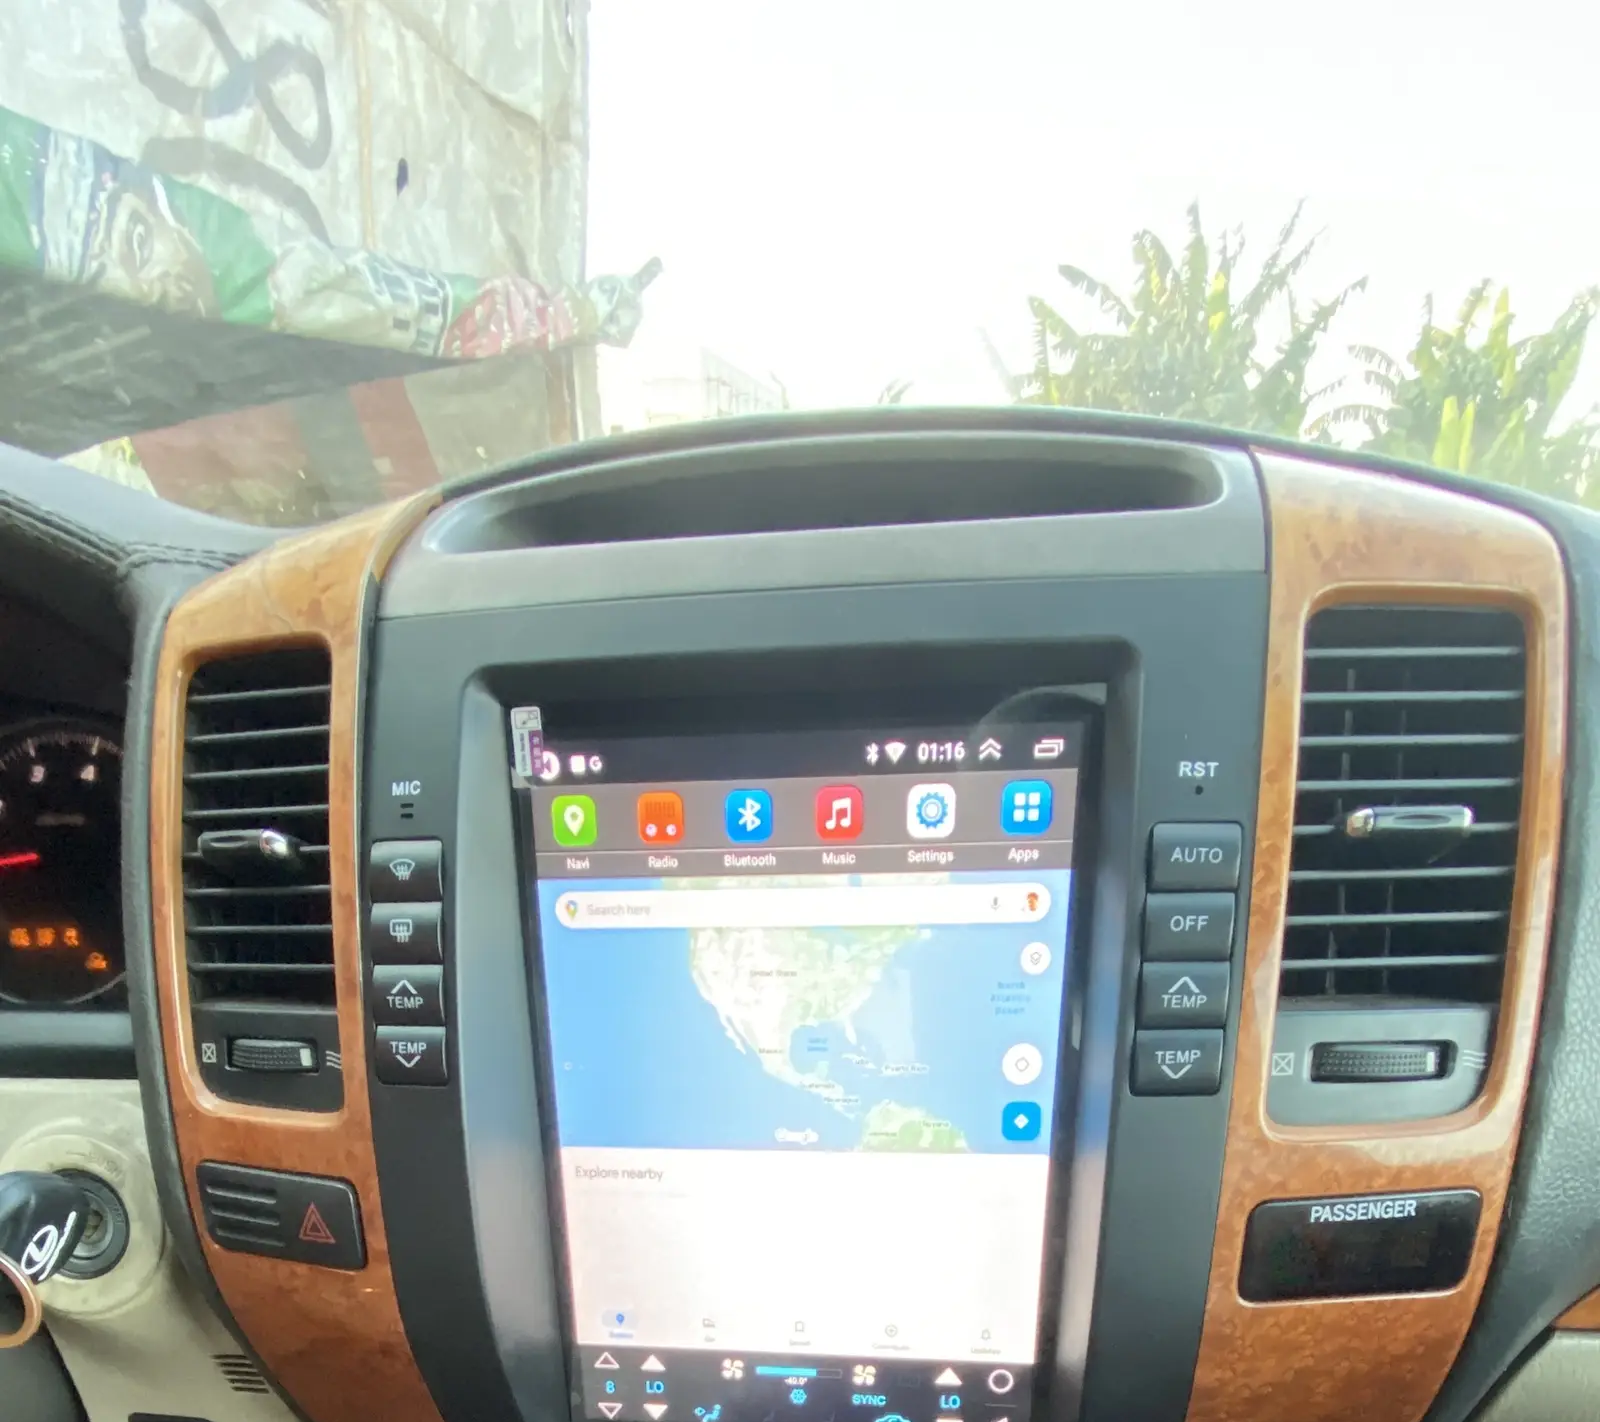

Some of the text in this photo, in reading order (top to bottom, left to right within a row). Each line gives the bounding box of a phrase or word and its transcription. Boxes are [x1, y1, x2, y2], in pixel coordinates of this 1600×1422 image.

[917, 742, 966, 762] 01:16
[80, 764, 95, 782] 4
[1178, 761, 1219, 778] RST
[391, 780, 421, 795] MIC
[648, 855, 679, 869] Radio
[724, 853, 776, 868] Bluetooth
[822, 851, 856, 864] Music
[907, 848, 955, 866] Settings
[1008, 847, 1040, 863] Apps
[1170, 846, 1223, 865] AUTO
[566, 857, 590, 869] Navi
[586, 903, 651, 917] Search here
[1169, 915, 1209, 932] OFF
[387, 995, 424, 1009] TEMP
[1162, 993, 1207, 1009] TEMP
[390, 1041, 427, 1055] TEMP
[1154, 1049, 1201, 1065] TEMP
[576, 1167, 663, 1183] Explore nearby
[1309, 1200, 1417, 1223] PASSENGER
[645, 1380, 665, 1394] LO
[852, 1393, 887, 1407] SYNC
[939, 1395, 961, 1409] LO
